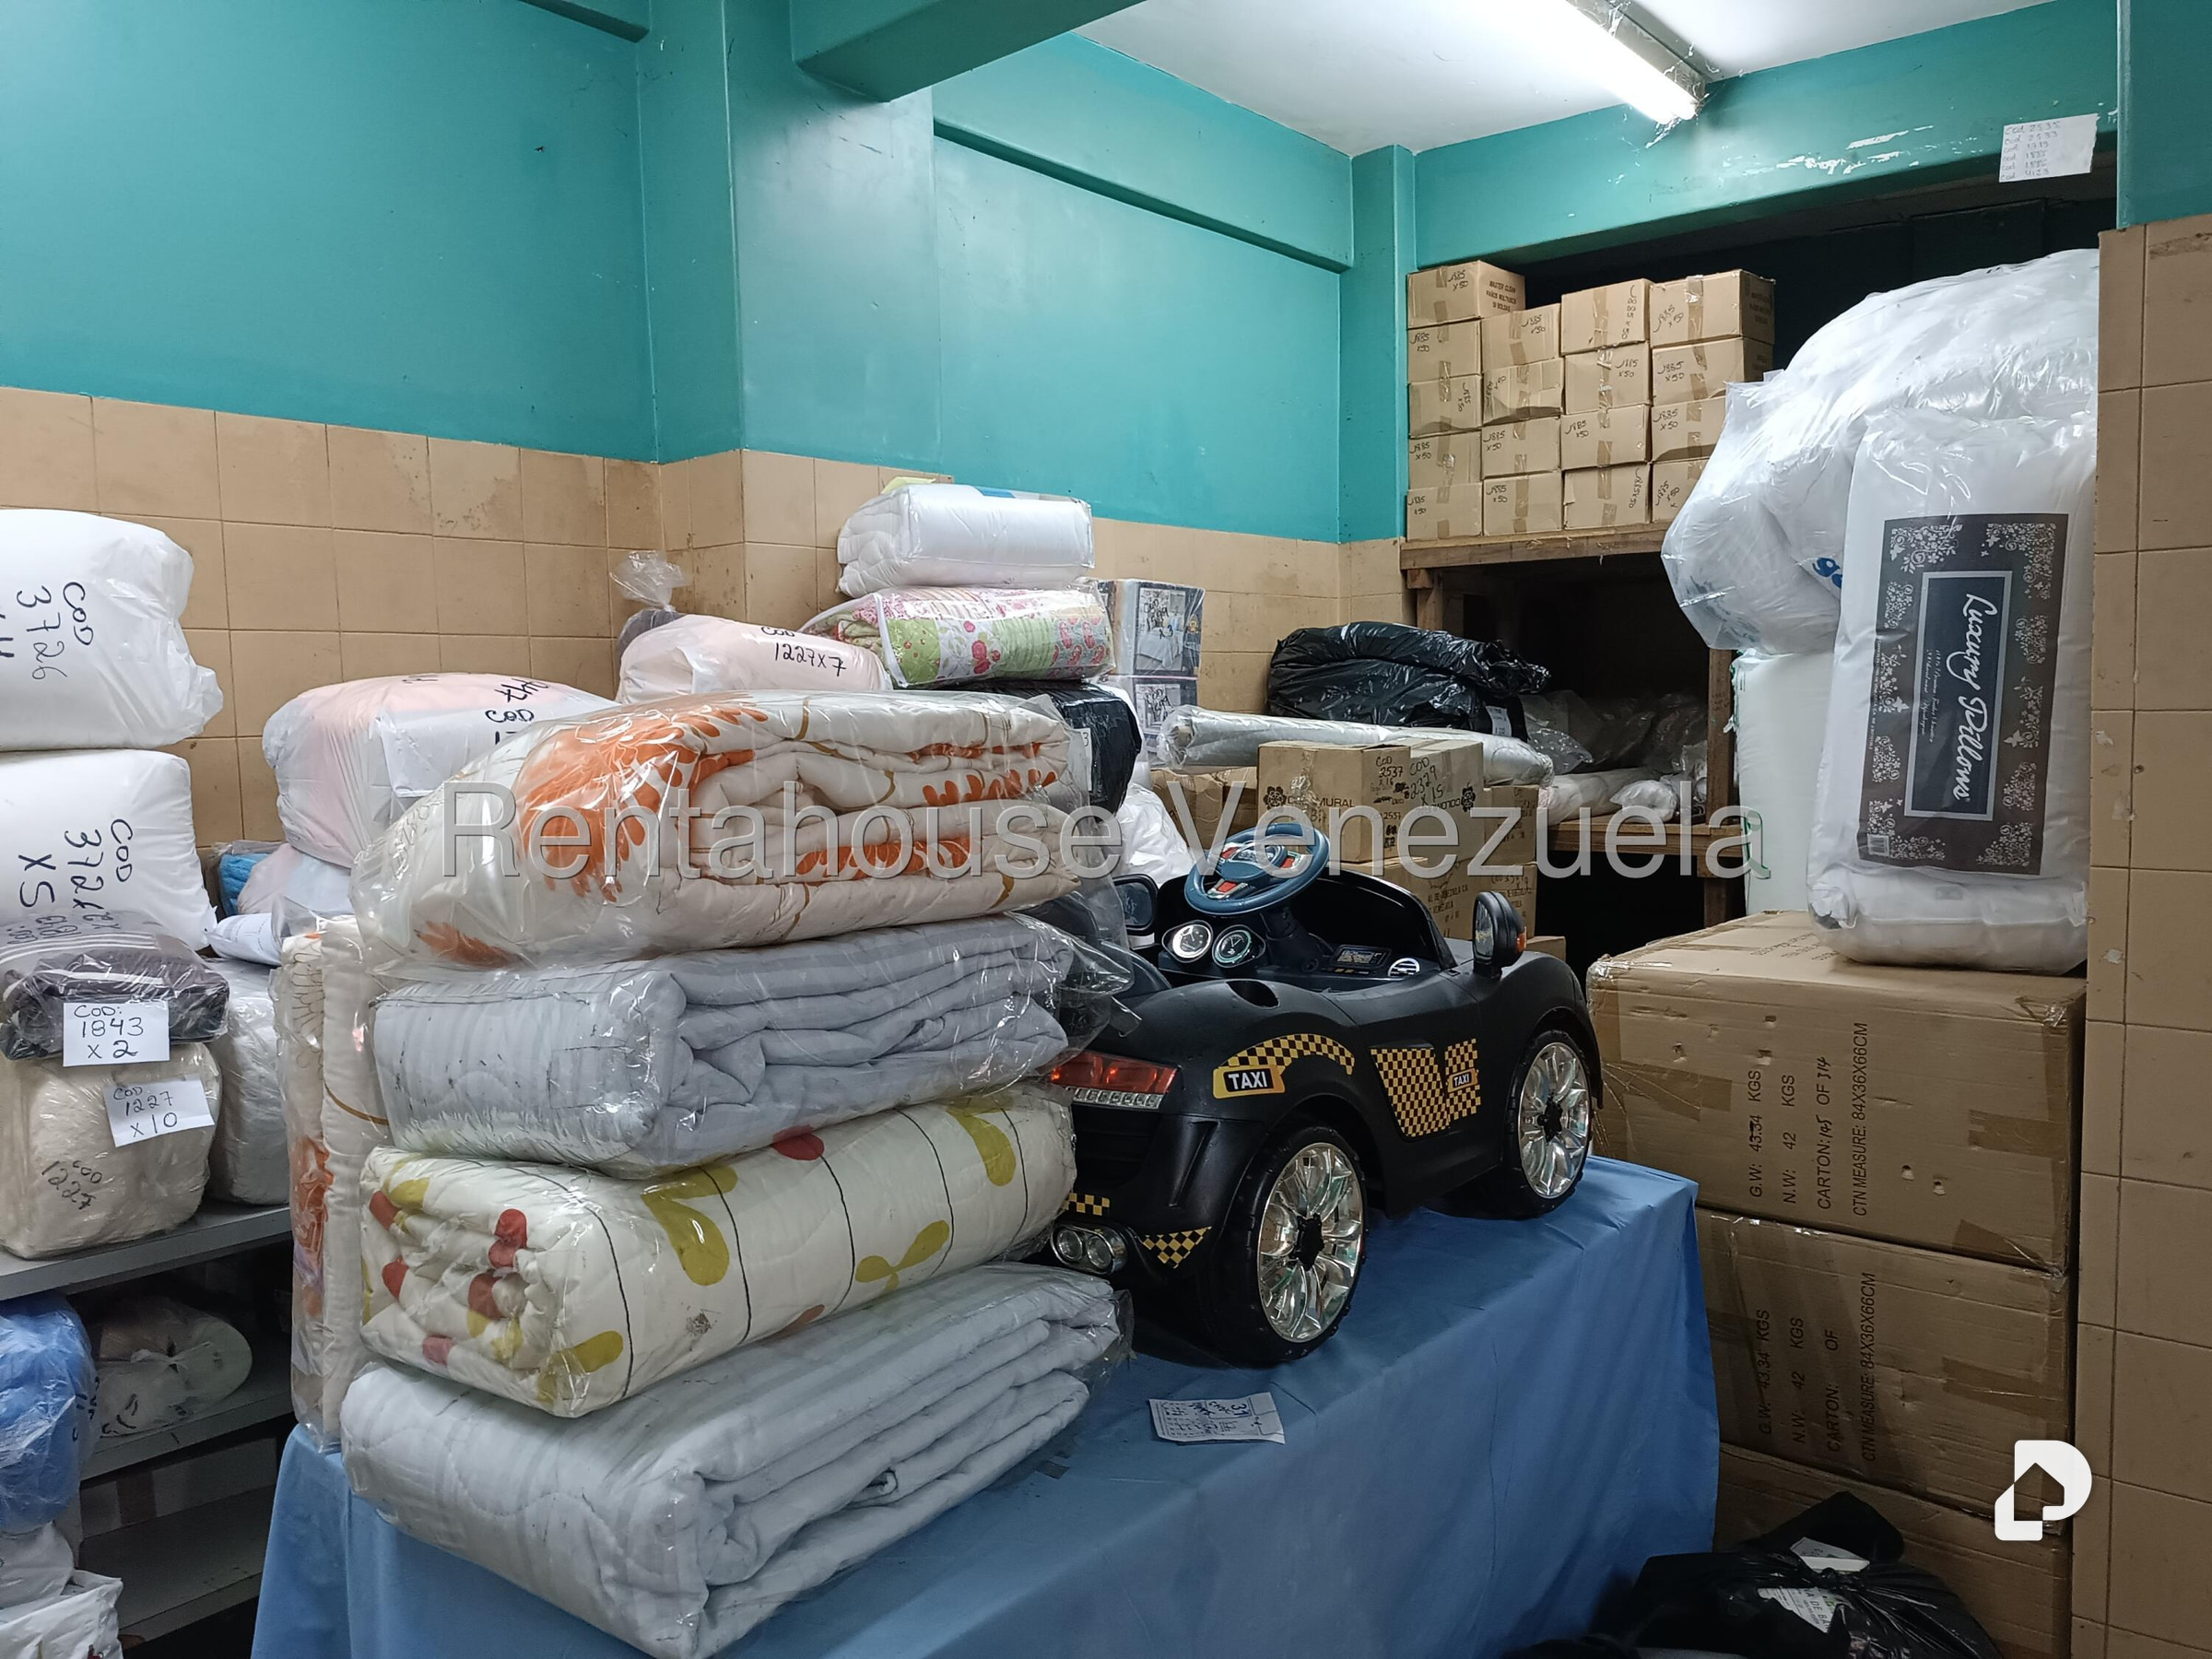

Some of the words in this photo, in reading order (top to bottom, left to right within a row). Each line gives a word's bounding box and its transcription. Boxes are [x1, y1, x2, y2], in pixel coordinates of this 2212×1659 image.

[63, 582, 93, 645] COD
[17, 585, 67, 679] 3726
[1946, 593, 1998, 691] Luxury
[485, 709, 535, 724] COD
[1376, 756, 1392, 767] COD
[1953, 695, 1988, 801] Pillows
[1379, 766, 1403, 778] 2537
[1410, 757, 1430, 775] COD
[111, 819, 133, 882] COD
[82, 1017, 144, 1038] 1843
[1229, 1070, 1267, 1092] TAXI
[1453, 1073, 1470, 1088] TAXI
[1852, 1022, 1867, 1121] 84X36X66CM
[113, 1086, 143, 1100] COD
[1747, 1070, 1761, 1102] KGS
[1782, 1074, 1794, 1107] KGS
[1816, 1083, 1830, 1105] OF
[125, 1091, 173, 1116] 1227
[1783, 1132, 1796, 1150] 42
[1853, 1124, 1867, 1189] MEASURE:
[1783, 1169, 1796, 1204] N.W:
[1853, 1190, 1867, 1217] CTN
[1756, 1309, 1770, 1342] KGS
[1790, 1316, 1804, 1349] KGS
[1861, 1272, 1877, 1370] 84X36X66CM
[1824, 1329, 1839, 1352] OF
[1792, 1371, 1806, 1390] 42
[1862, 1435, 1877, 1462] CTN
